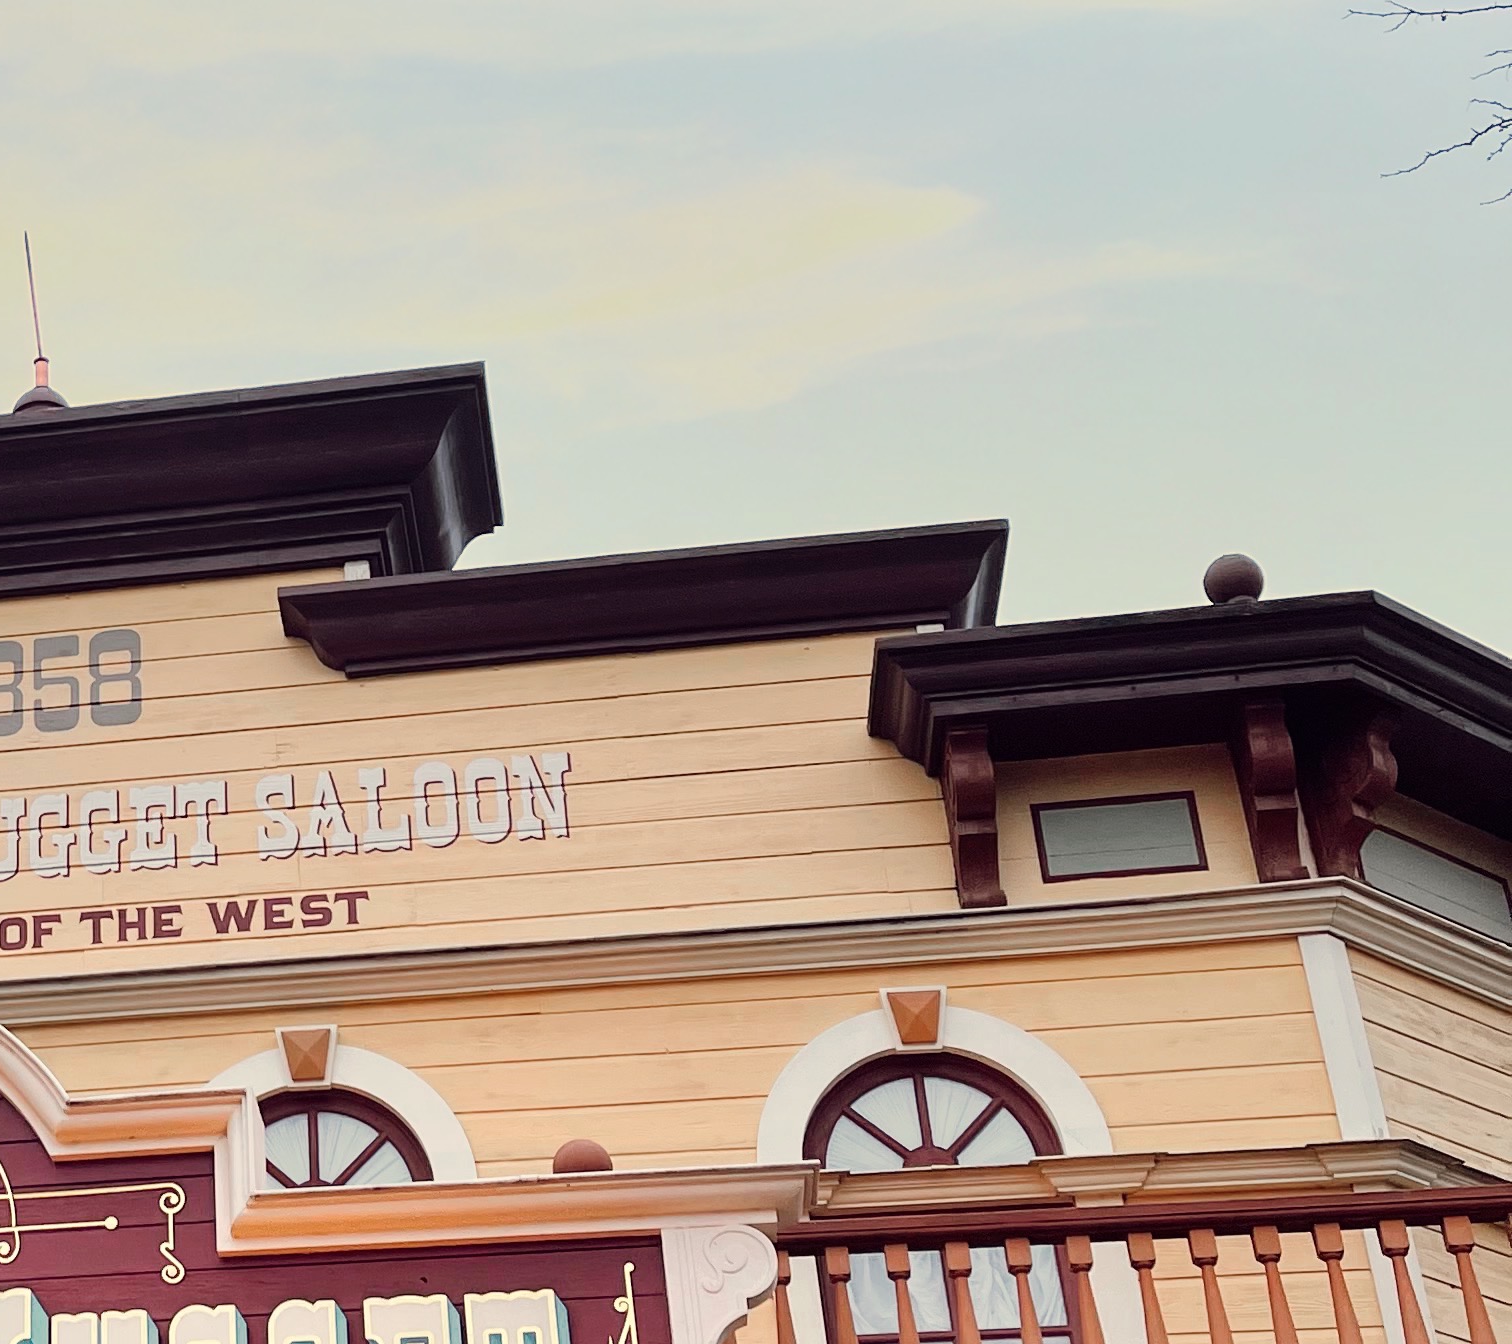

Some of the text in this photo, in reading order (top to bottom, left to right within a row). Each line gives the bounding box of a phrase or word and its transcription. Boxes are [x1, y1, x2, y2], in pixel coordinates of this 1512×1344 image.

[256, 752, 573, 860] SALOON
[79, 904, 184, 946] THE
[204, 892, 371, 933] WEST
